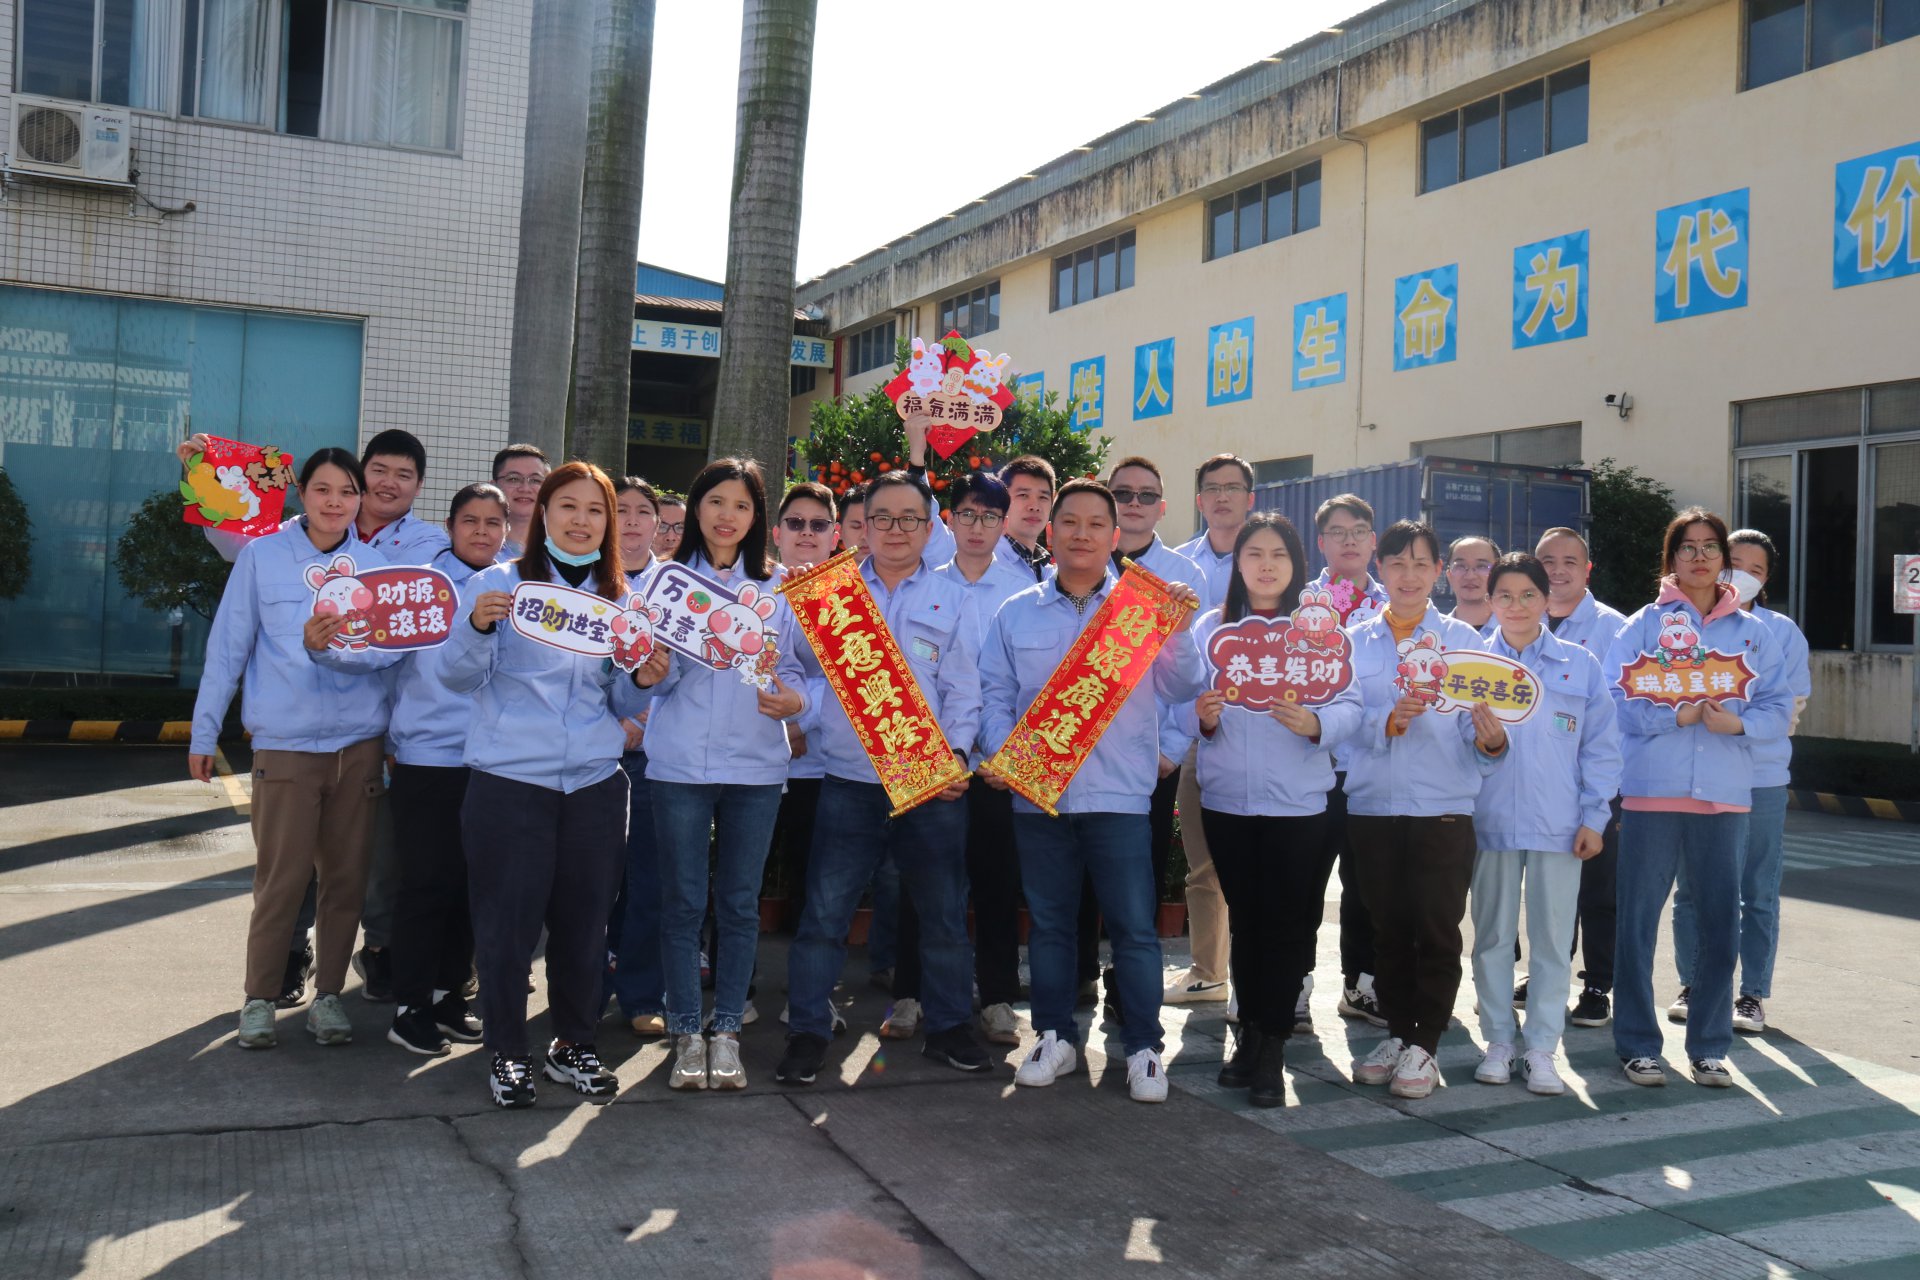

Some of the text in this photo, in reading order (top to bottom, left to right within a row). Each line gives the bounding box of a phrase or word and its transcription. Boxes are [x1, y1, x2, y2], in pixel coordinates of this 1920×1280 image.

[661, 326, 718, 353] 勇于创
[791, 339, 827, 364] 发展
[903, 395, 996, 425] 福氣满满
[377, 576, 436, 605] 财源
[662, 574, 689, 602] 万
[389, 605, 448, 637] 滚滚
[516, 597, 611, 644] 招财进宝
[817, 592, 924, 755] 生意興隆
[1225, 653, 1343, 687] 恭喜发财
[1635, 671, 1736, 694] 瑞兔呈祥
[1447, 673, 1533, 705] 平安喜乐
